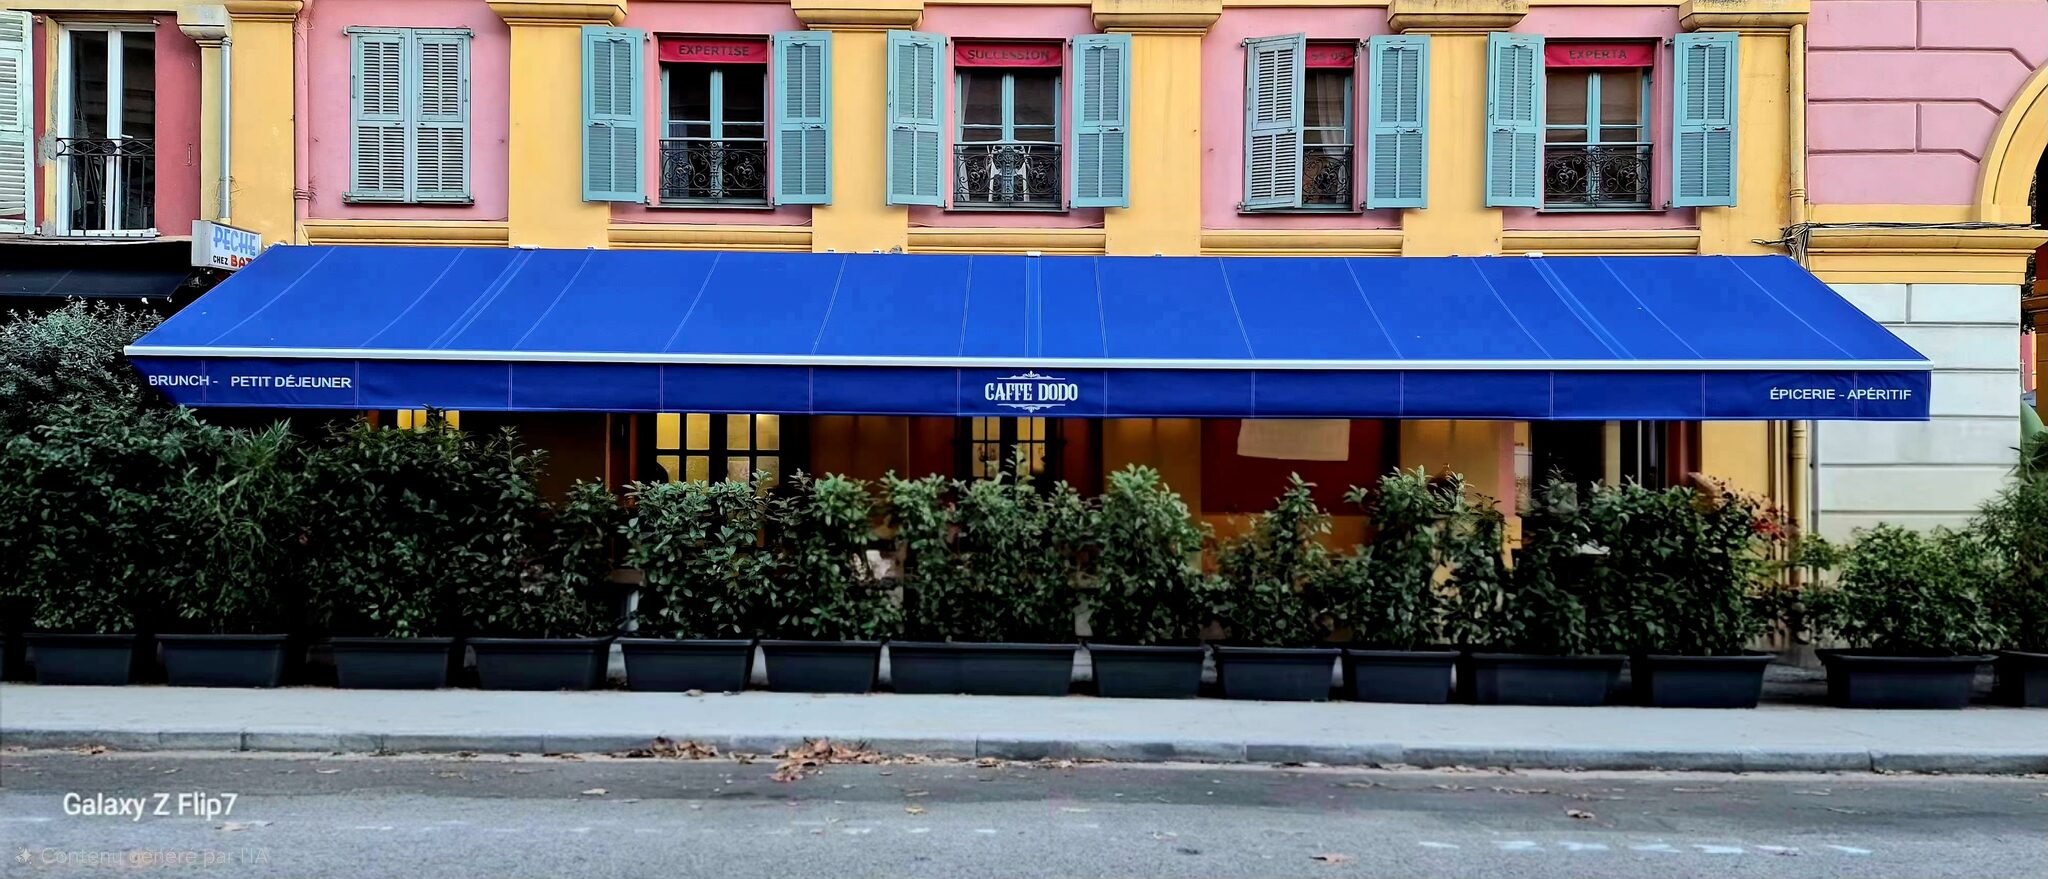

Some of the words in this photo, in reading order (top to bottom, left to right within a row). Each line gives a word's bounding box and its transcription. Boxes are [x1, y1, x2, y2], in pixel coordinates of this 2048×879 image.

[678, 45, 750, 56] EXPERTISE
[967, 49, 1050, 60] SUCCESSION
[1568, 49, 1627, 60] EXPERTA
[213, 226, 256, 257] PECHE
[212, 255, 229, 266] CHEZ
[149, 375, 209, 386] BRUNCH
[231, 376, 271, 388] PETIT
[275, 375, 352, 389] DÉJEUNER
[984, 382, 1033, 401] CAFFE
[1038, 382, 1079, 402] DODO
[1769, 387, 1836, 400] ÉPICERIE
[1847, 387, 1912, 400] APÉRITIF
